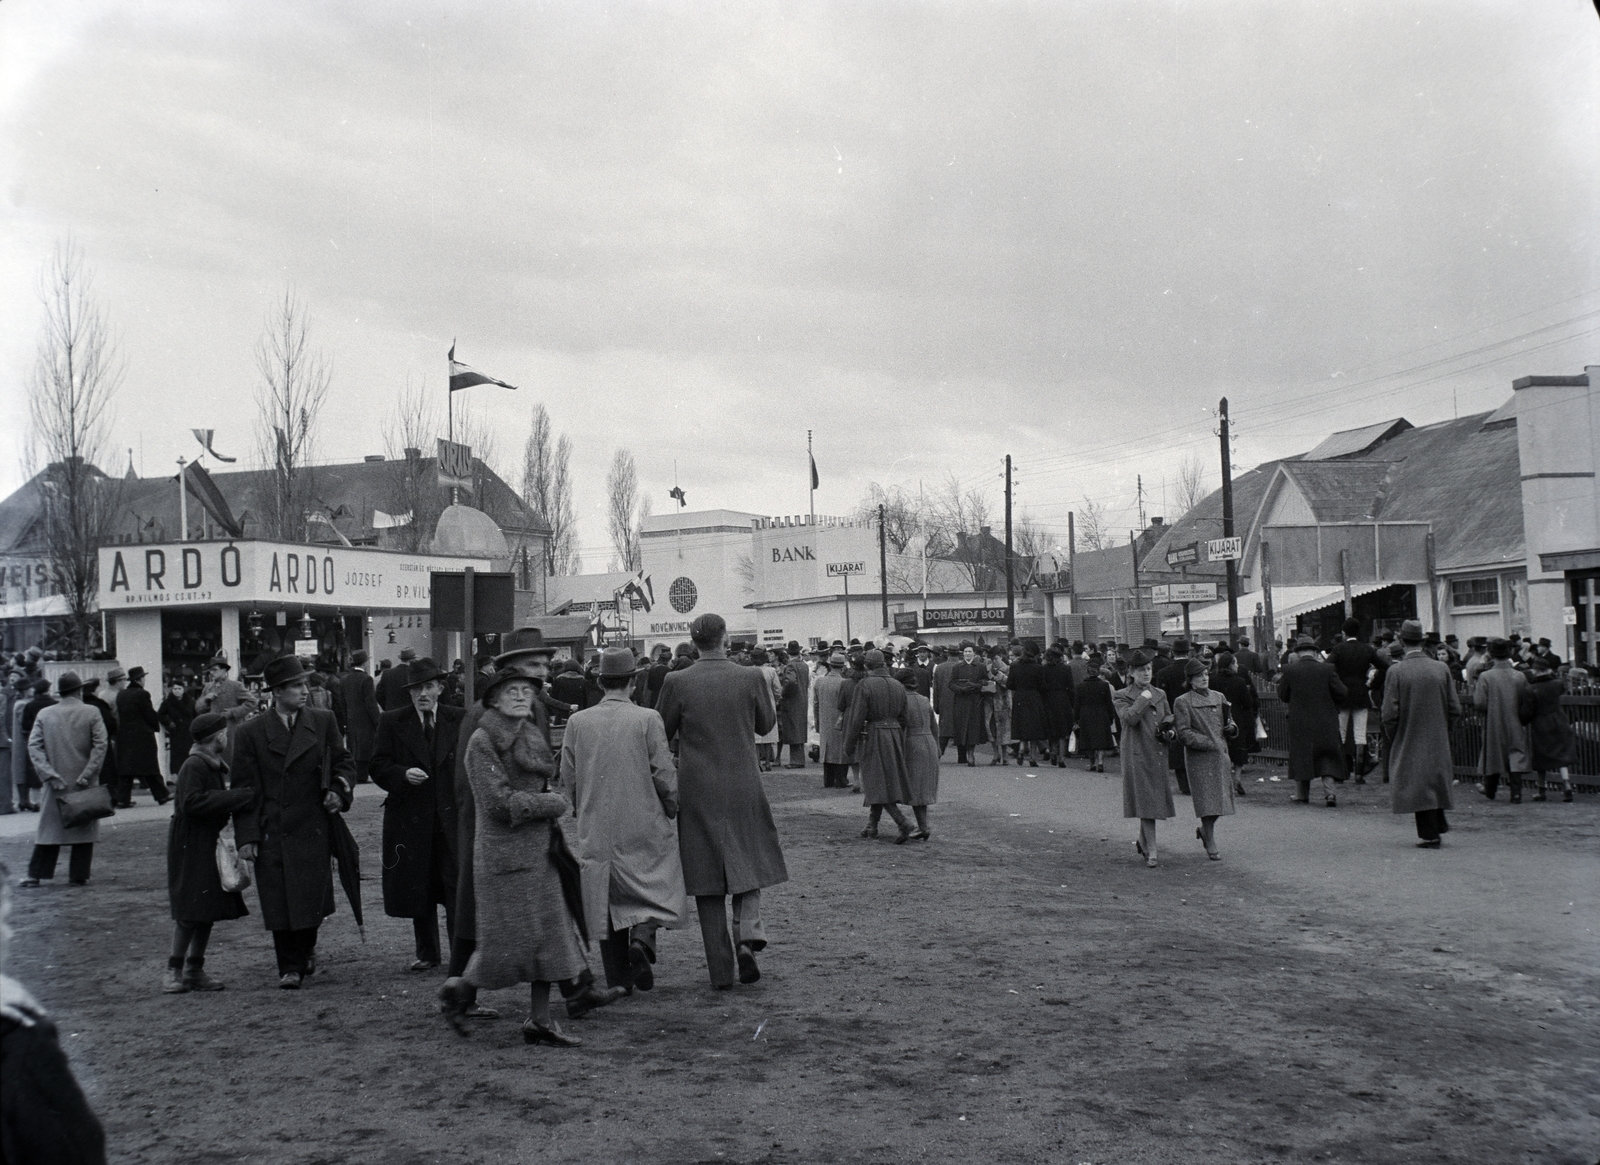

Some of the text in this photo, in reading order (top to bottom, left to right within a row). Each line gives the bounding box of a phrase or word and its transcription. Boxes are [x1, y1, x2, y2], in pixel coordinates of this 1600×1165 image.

[772, 546, 816, 562] BANK
[1209, 538, 1240, 555] KIJÁRAT
[110, 541, 241, 592] ARDÓ
[259, 548, 383, 595] ARDÓ JÓZSEF
[829, 562, 864, 573] KIJÁRAT
[925, 609, 978, 620] DOHÁNYOS
[981, 609, 1005, 619] BOLT
